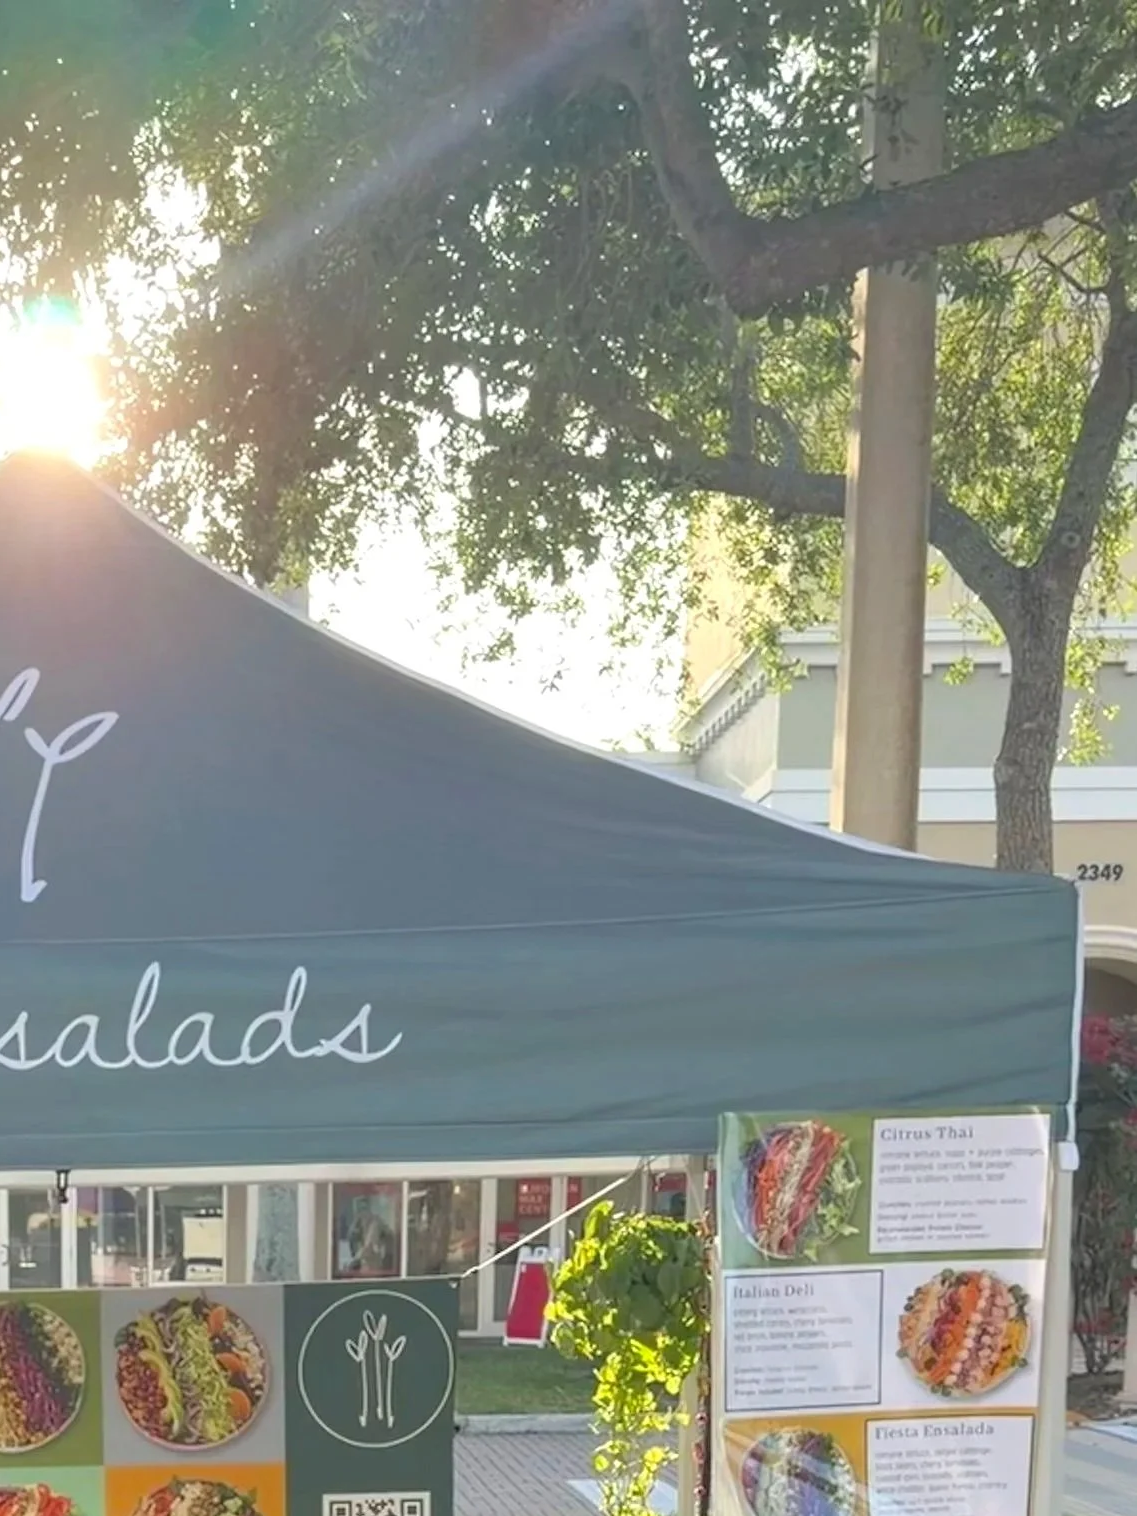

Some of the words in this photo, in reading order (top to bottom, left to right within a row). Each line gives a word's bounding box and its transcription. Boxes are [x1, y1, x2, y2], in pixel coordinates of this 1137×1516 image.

[1076, 863, 1124, 881] 2349
[879, 1125, 932, 1141] Citrus
[937, 1125, 975, 1140] Thai
[733, 1285, 780, 1300] Italian
[784, 1283, 815, 1298] Deli
[875, 1425, 919, 1440] Fiesta
[923, 1422, 995, 1438] Ensalada
